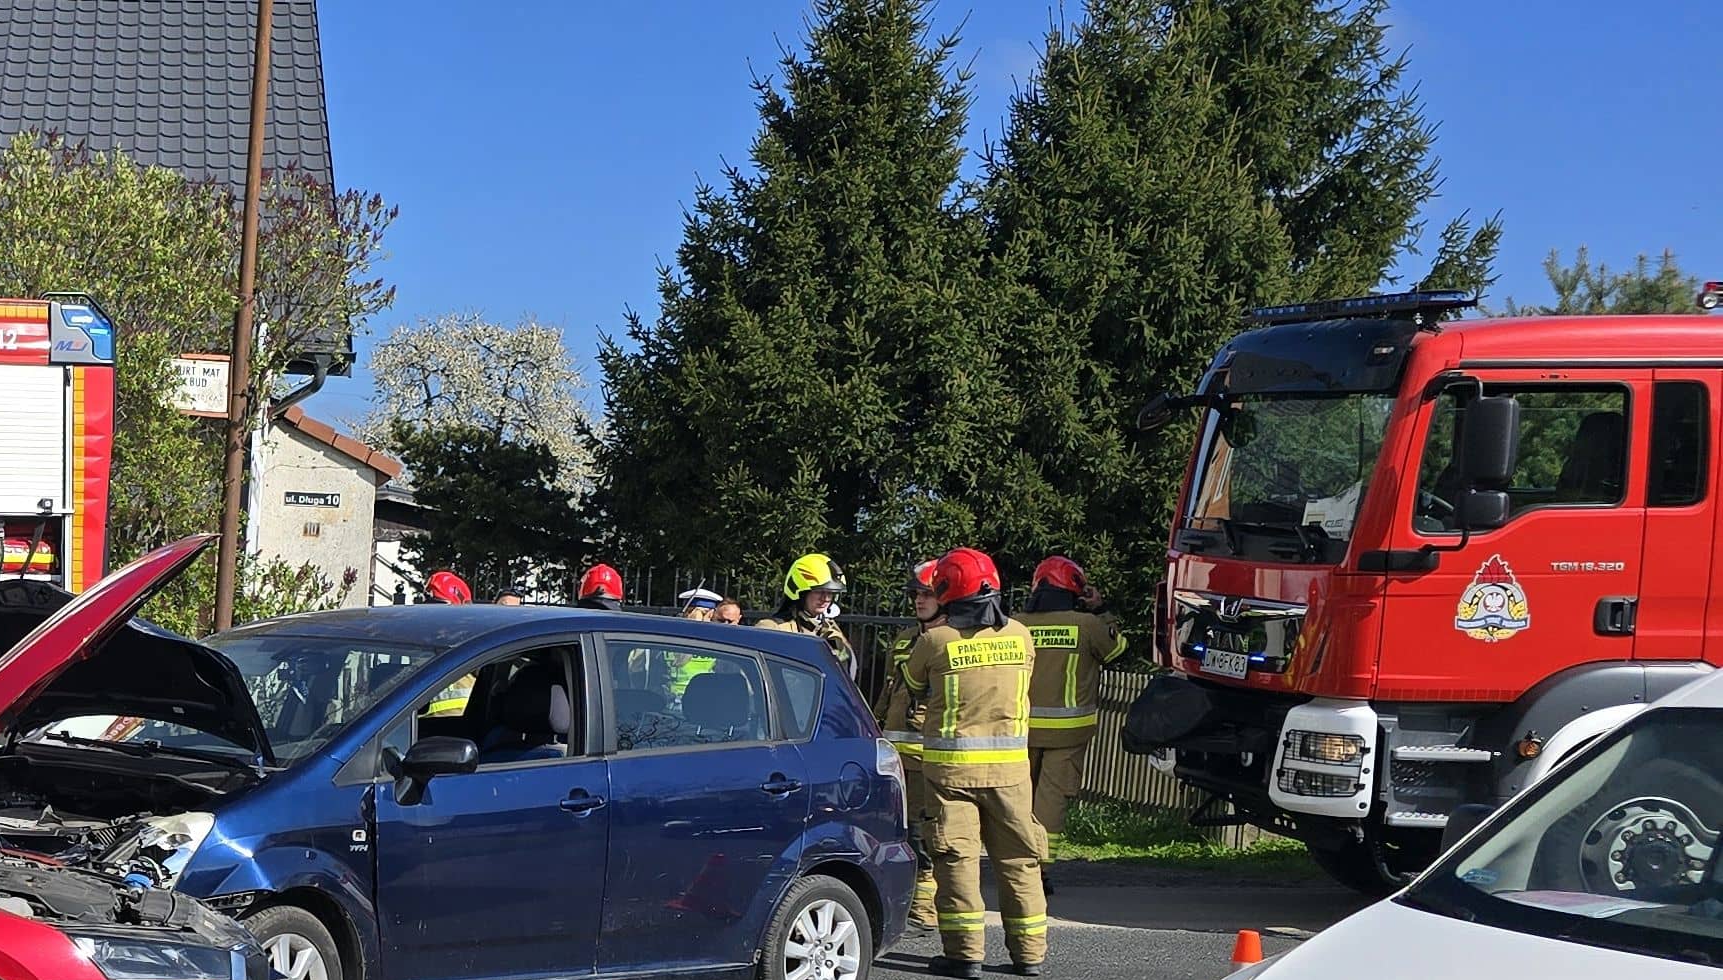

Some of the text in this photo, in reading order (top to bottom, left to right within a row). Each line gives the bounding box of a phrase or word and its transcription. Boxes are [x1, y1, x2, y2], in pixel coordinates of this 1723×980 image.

[202, 367, 221, 377] MAT
[189, 377, 207, 387] BUD
[285, 494, 340, 506] ul. Długa 10
[1551, 562, 1625, 571] TGM 18.320
